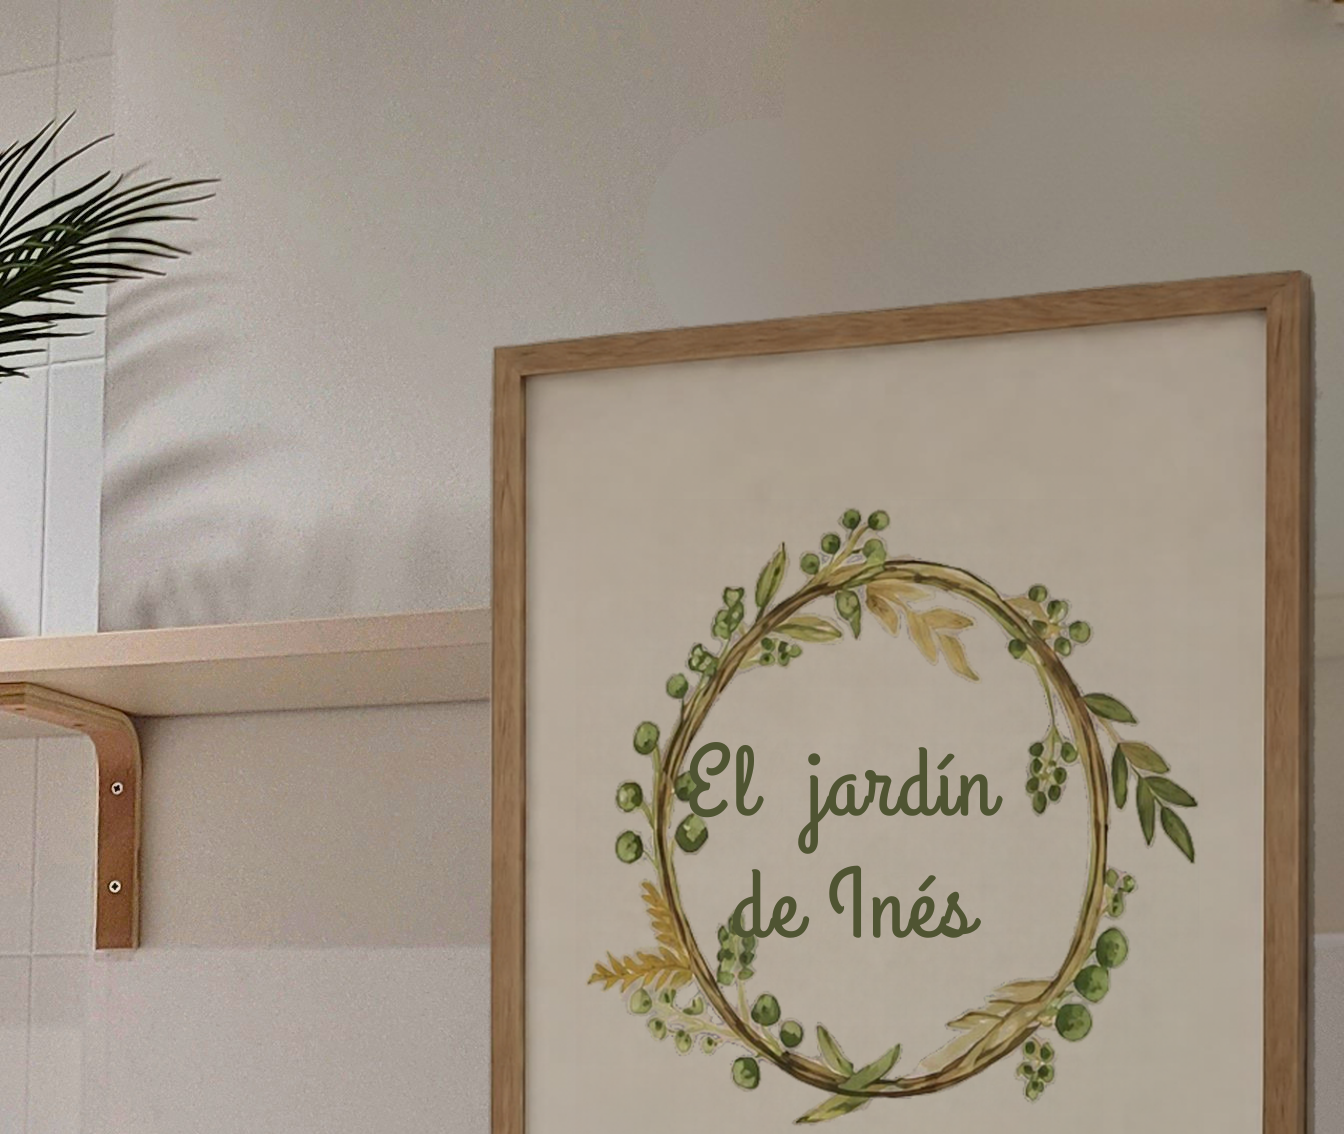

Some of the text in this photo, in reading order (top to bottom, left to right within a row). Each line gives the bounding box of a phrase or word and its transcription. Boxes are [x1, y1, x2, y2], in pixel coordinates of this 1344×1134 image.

[688, 741, 1003, 854] El jardín
[732, 865, 981, 938] de Inés
